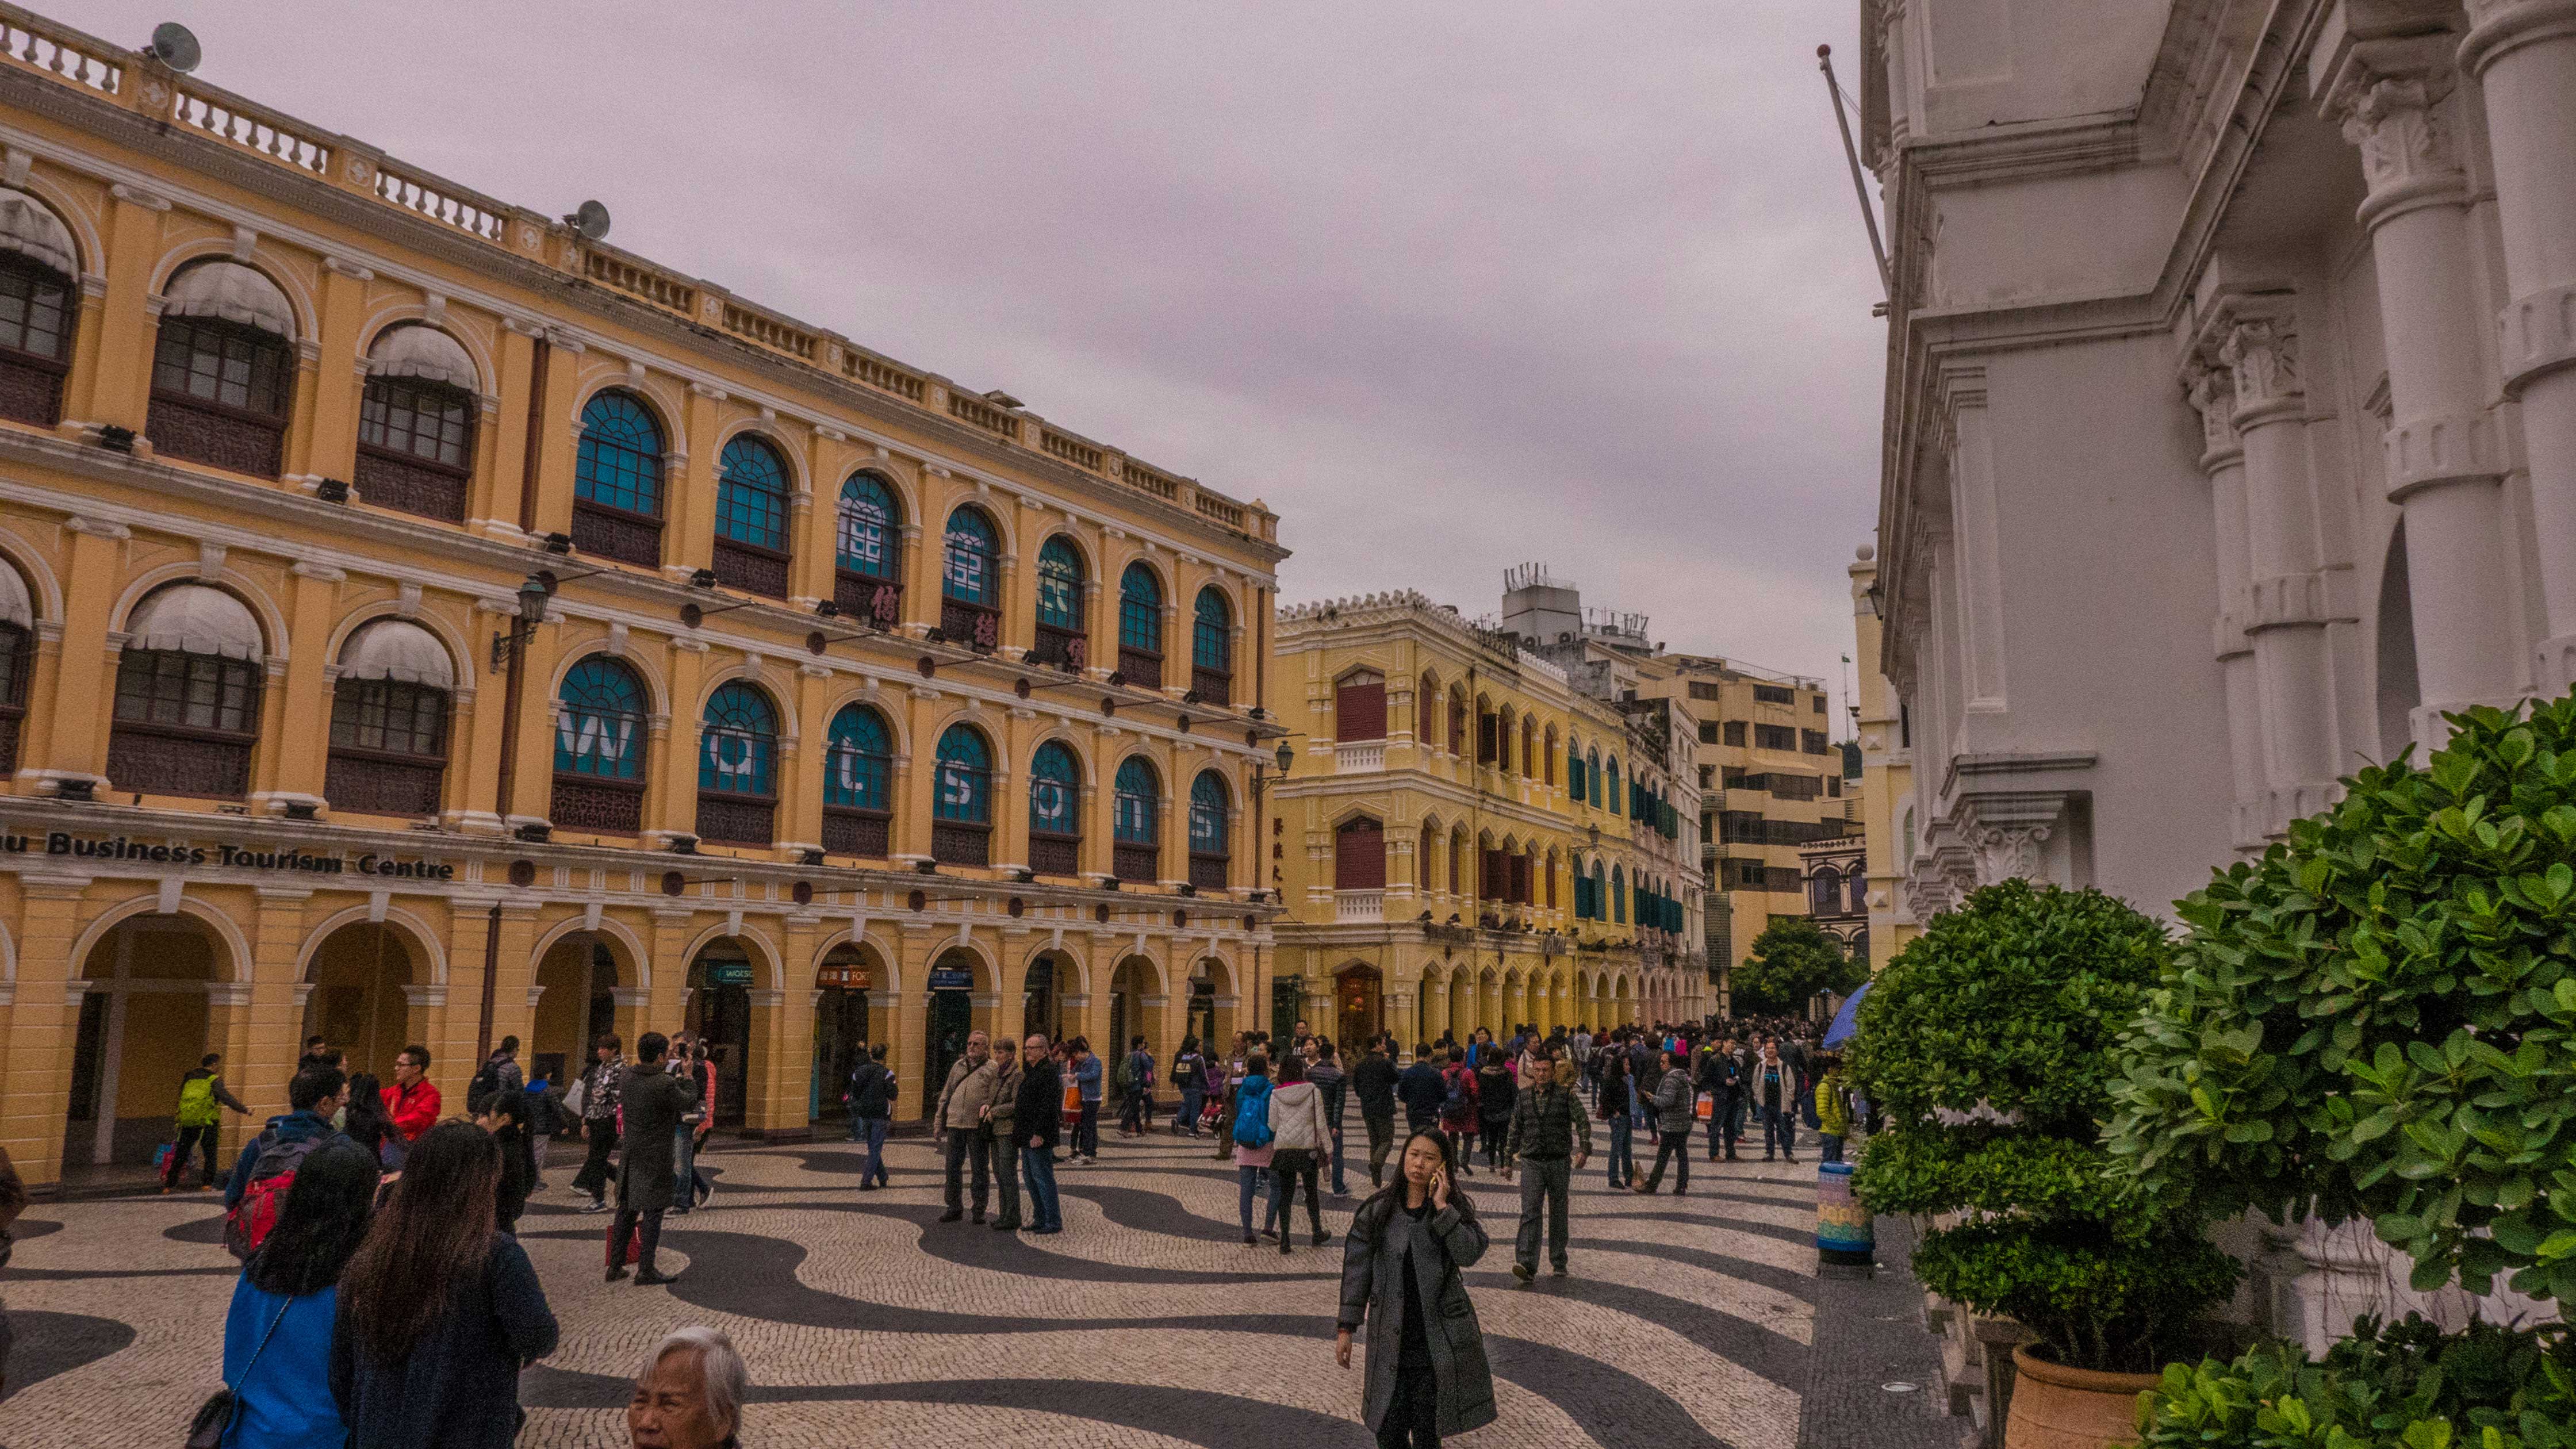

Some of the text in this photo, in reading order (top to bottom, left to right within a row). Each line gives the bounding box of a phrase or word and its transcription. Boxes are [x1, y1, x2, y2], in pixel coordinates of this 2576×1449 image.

[0, 832, 454, 880] u Business Tourism Centre
